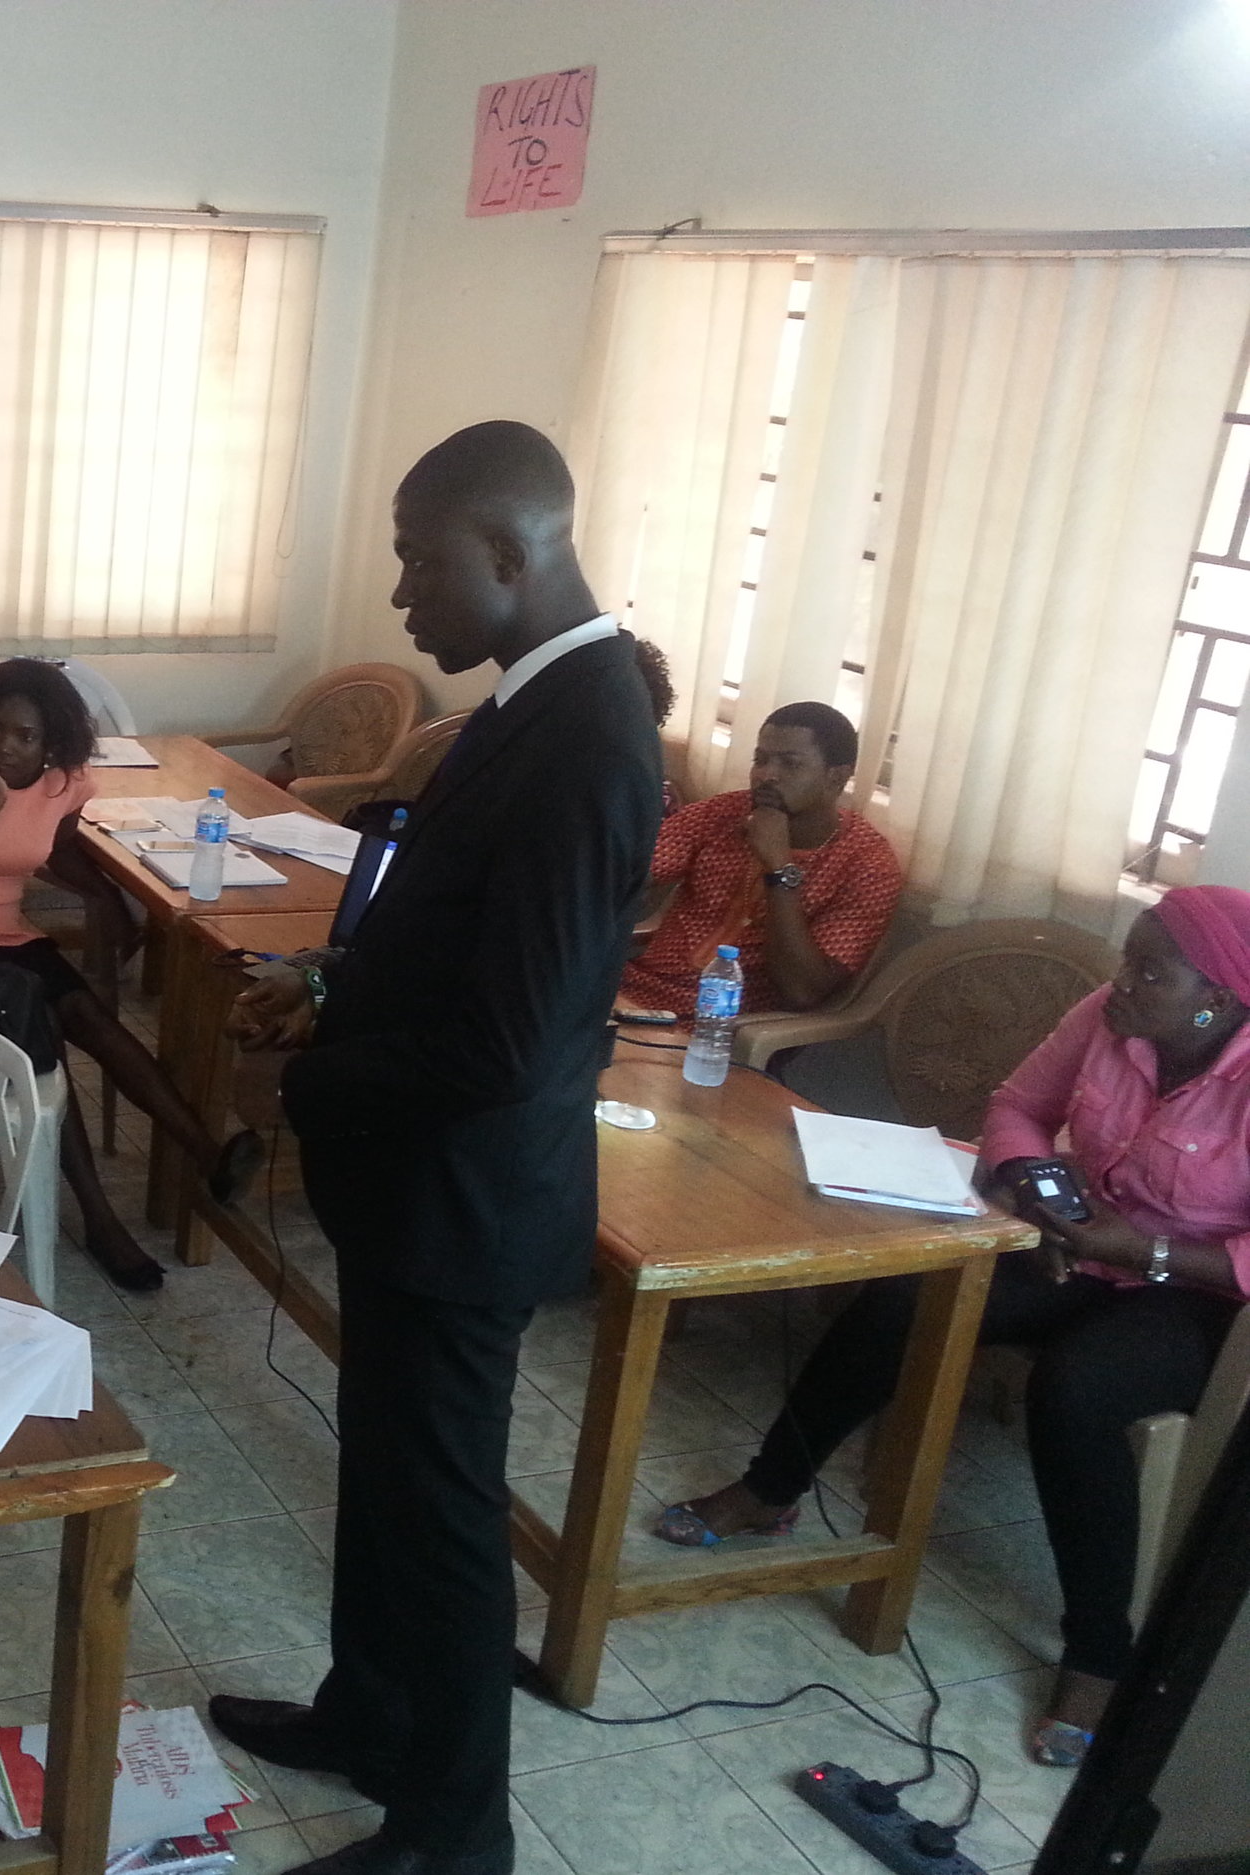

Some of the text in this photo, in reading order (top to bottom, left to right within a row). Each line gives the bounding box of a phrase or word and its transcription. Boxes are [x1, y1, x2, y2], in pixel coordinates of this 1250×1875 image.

[483, 69, 588, 134] RIGHTS
[508, 135, 547, 168] TO
[480, 163, 563, 208] LIFE
